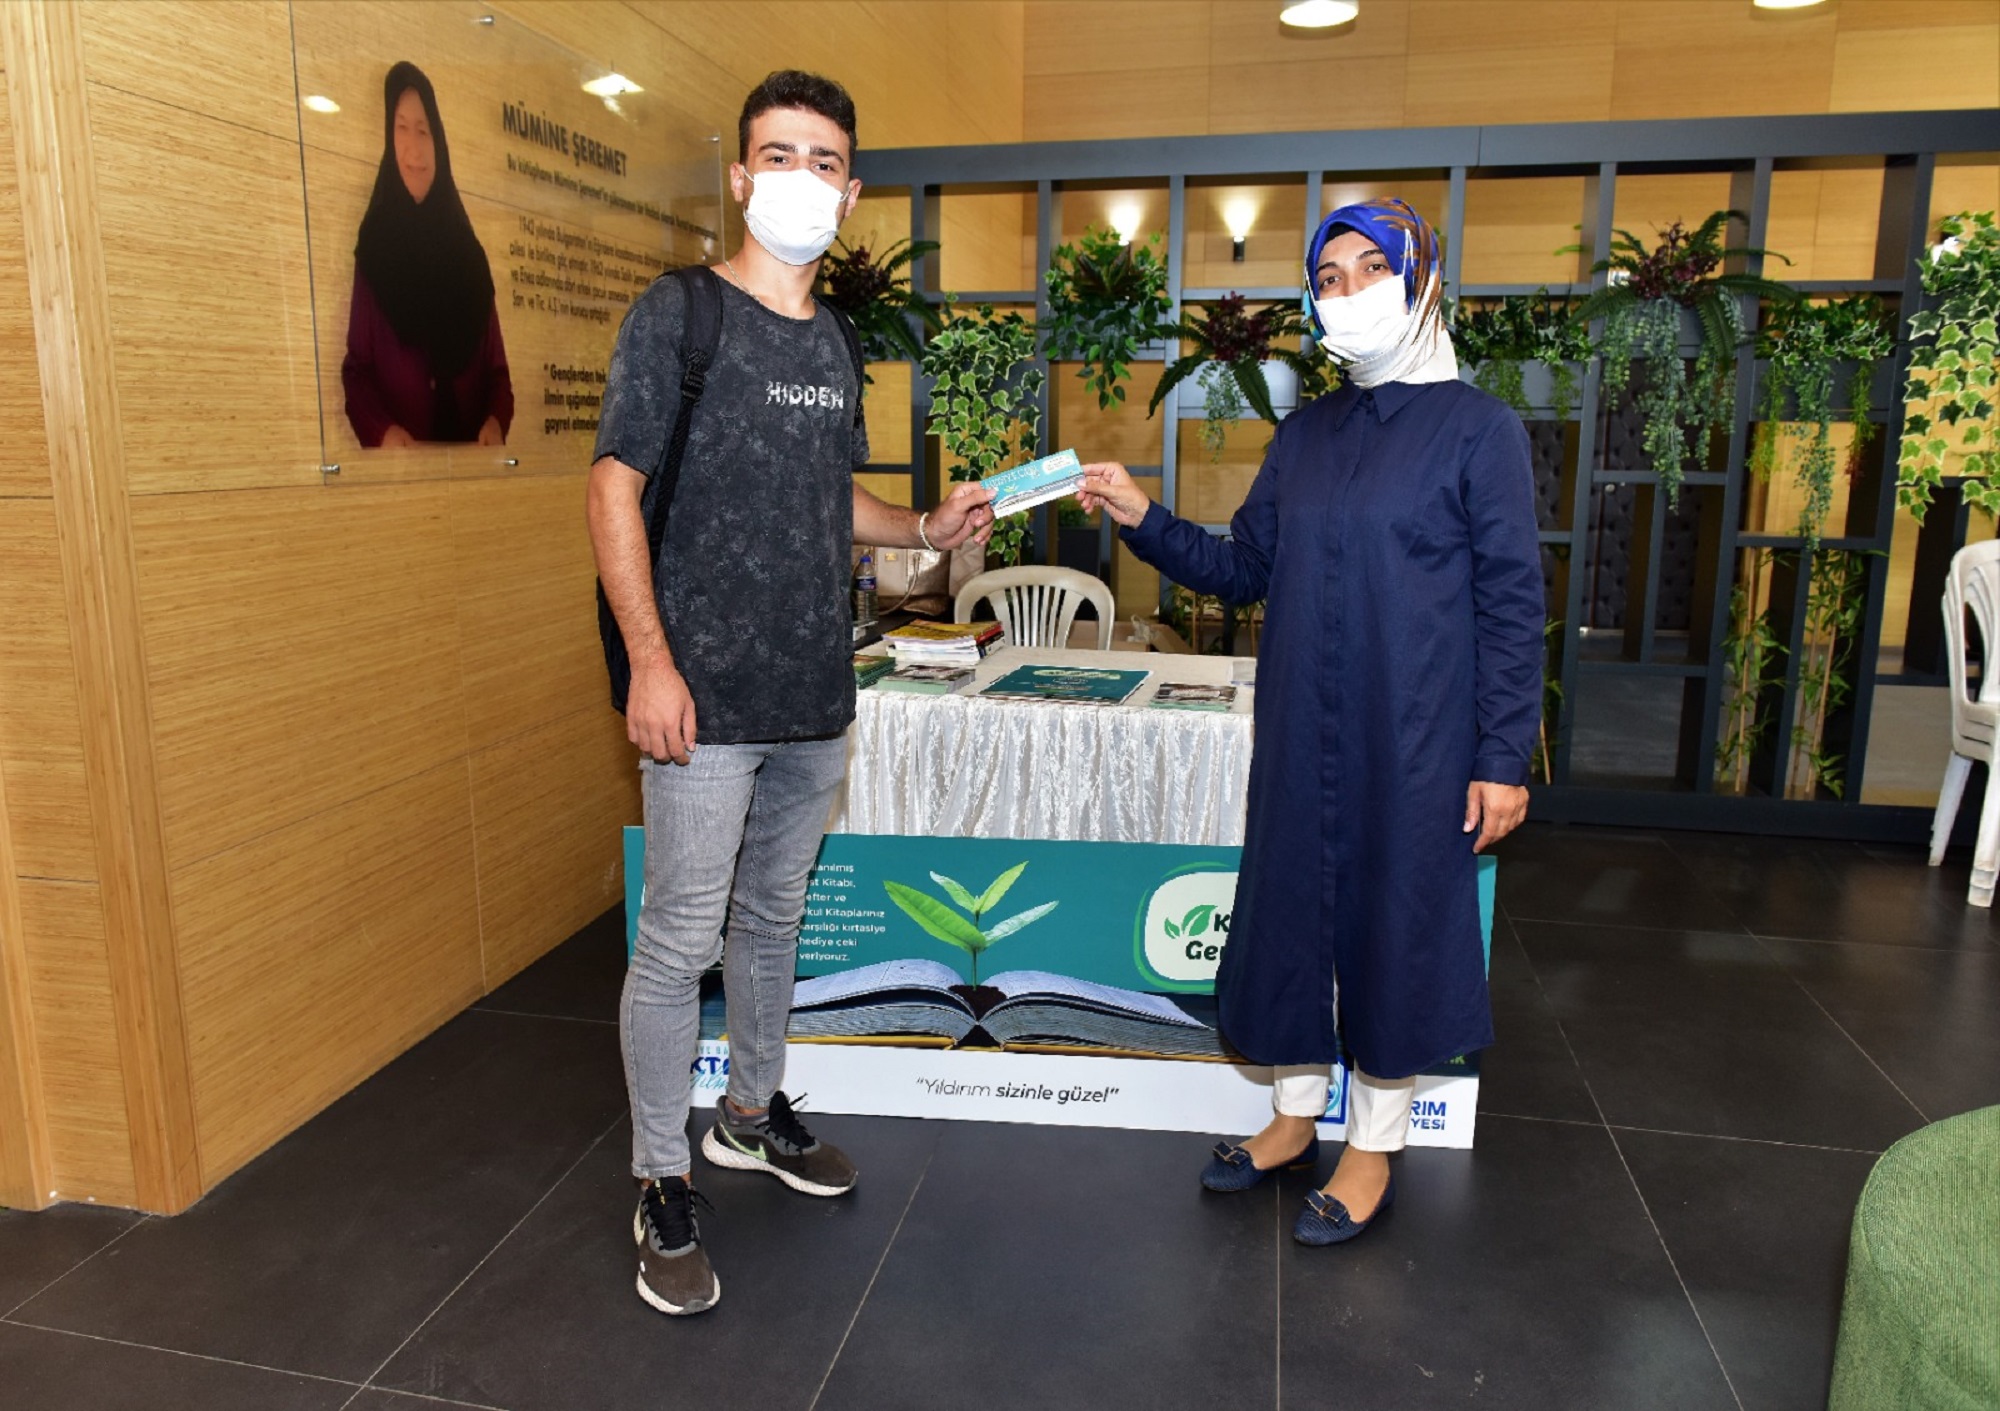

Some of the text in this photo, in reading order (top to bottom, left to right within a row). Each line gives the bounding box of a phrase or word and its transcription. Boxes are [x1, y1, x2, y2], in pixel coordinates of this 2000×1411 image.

[503, 101, 627, 177] MÜMİNE ŞEREMET
[765, 381, 844, 410] HIDDEN
[814, 863, 854, 873] lanılmış
[805, 892, 847, 902] efter ve
[825, 907, 885, 918] Kitaplarınız
[1213, 913, 1231, 933] K
[799, 936, 857, 948] hediye çeki
[916, 1076, 1120, 1106] "Yıldırım sizinle güzel"
[1410, 1100, 1447, 1117] RIM
[1410, 1118, 1446, 1131] YESİ
